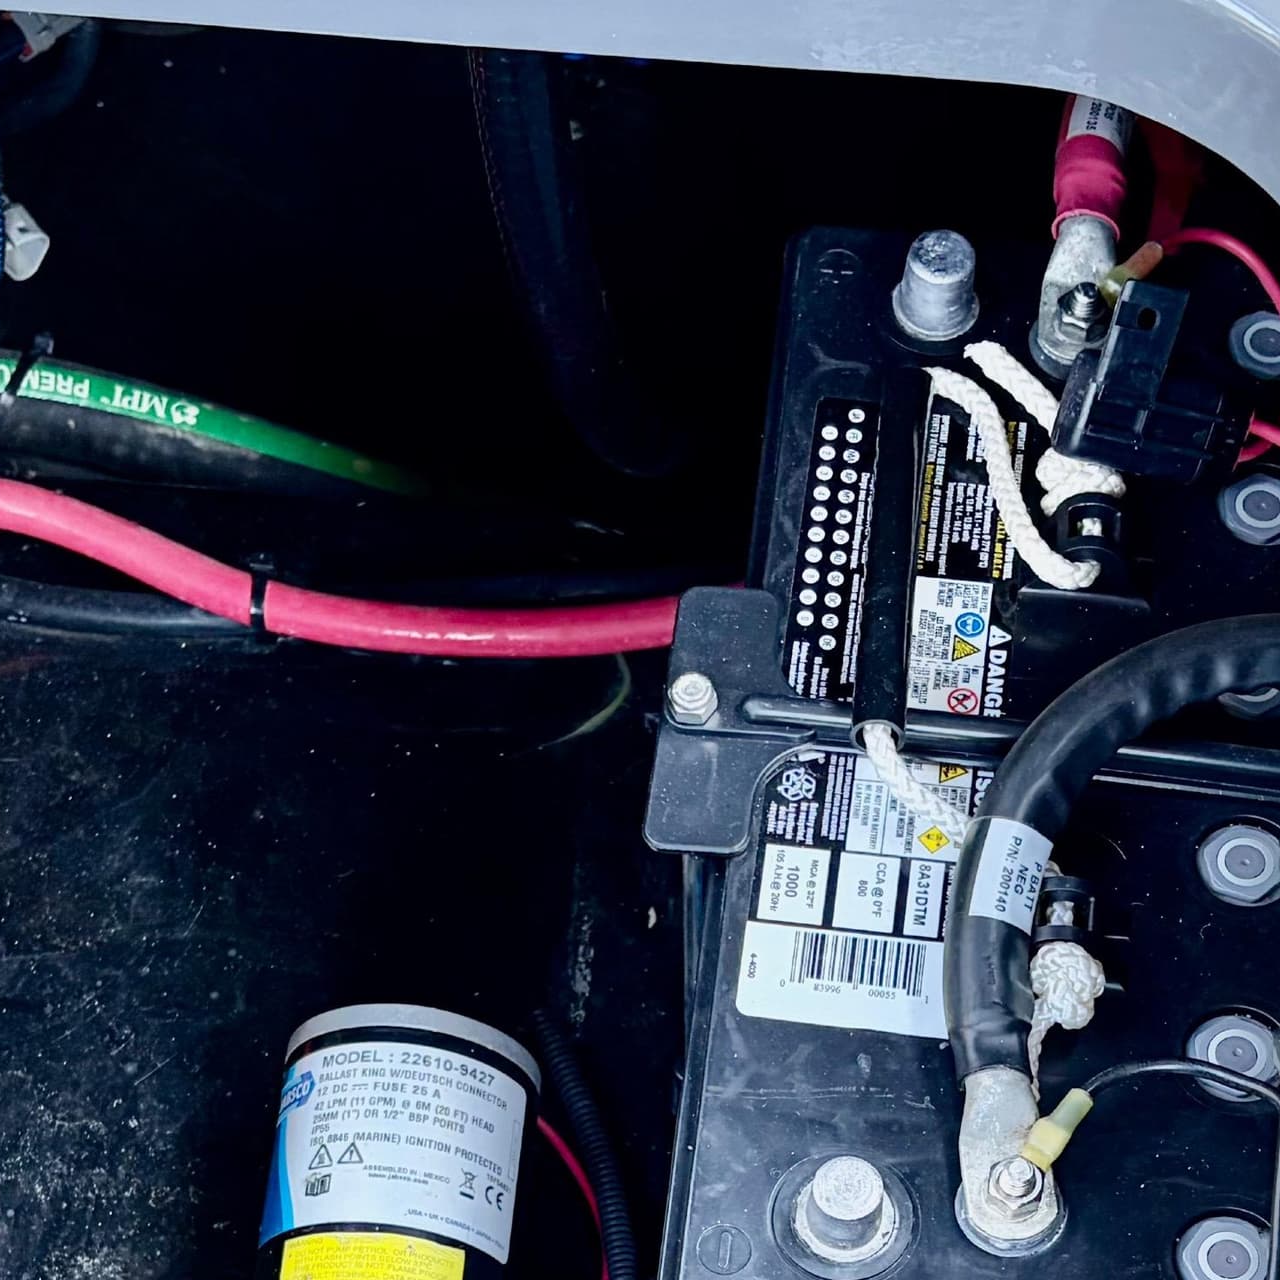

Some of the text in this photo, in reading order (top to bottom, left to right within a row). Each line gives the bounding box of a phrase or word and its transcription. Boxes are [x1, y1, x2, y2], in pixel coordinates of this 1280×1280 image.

[981, 648, 1007, 718] DANGE
[871, 807, 880, 822] OPEN
[775, 849, 785, 862] 105
[808, 859, 819, 878] MCA
[784, 864, 800, 898] 1000
[806, 879, 816, 889] @
[856, 879, 868, 897] 800
[874, 862, 887, 885] CCA
[990, 835, 1022, 913] P/N: 200140
[1011, 864, 1030, 895] NEG
[1021, 861, 1043, 912] P BATT
[870, 886, 883, 898] @
[911, 863, 932, 926] 8A31DTM
[868, 989, 896, 999] 00055
[322, 1049, 383, 1067] MODEL
[400, 1052, 496, 1083] 22610-9427
[317, 1087, 328, 1097] 12
[332, 1083, 348, 1093] DC
[373, 1082, 408, 1093] FUSE
[432, 1089, 441, 1099] A
[318, 1067, 508, 1111] BALLAST KING W/DEUTSCH CONNECTOR
[327, 1095, 347, 1108] LPM
[369, 1095, 397, 1108] GPM)
[402, 1099, 411, 1110] @
[453, 1108, 469, 1124] FT)
[472, 1115, 495, 1134] HEAD
[364, 1107, 380, 1118] OR
[409, 1111, 429, 1124] BSP
[432, 1117, 466, 1134] PORTS
[309, 1136, 324, 1148] ISO
[352, 1130, 402, 1145] (MARINE)
[405, 1135, 452, 1154] IGNITION
[454, 1147, 503, 1177] PROTECTED
